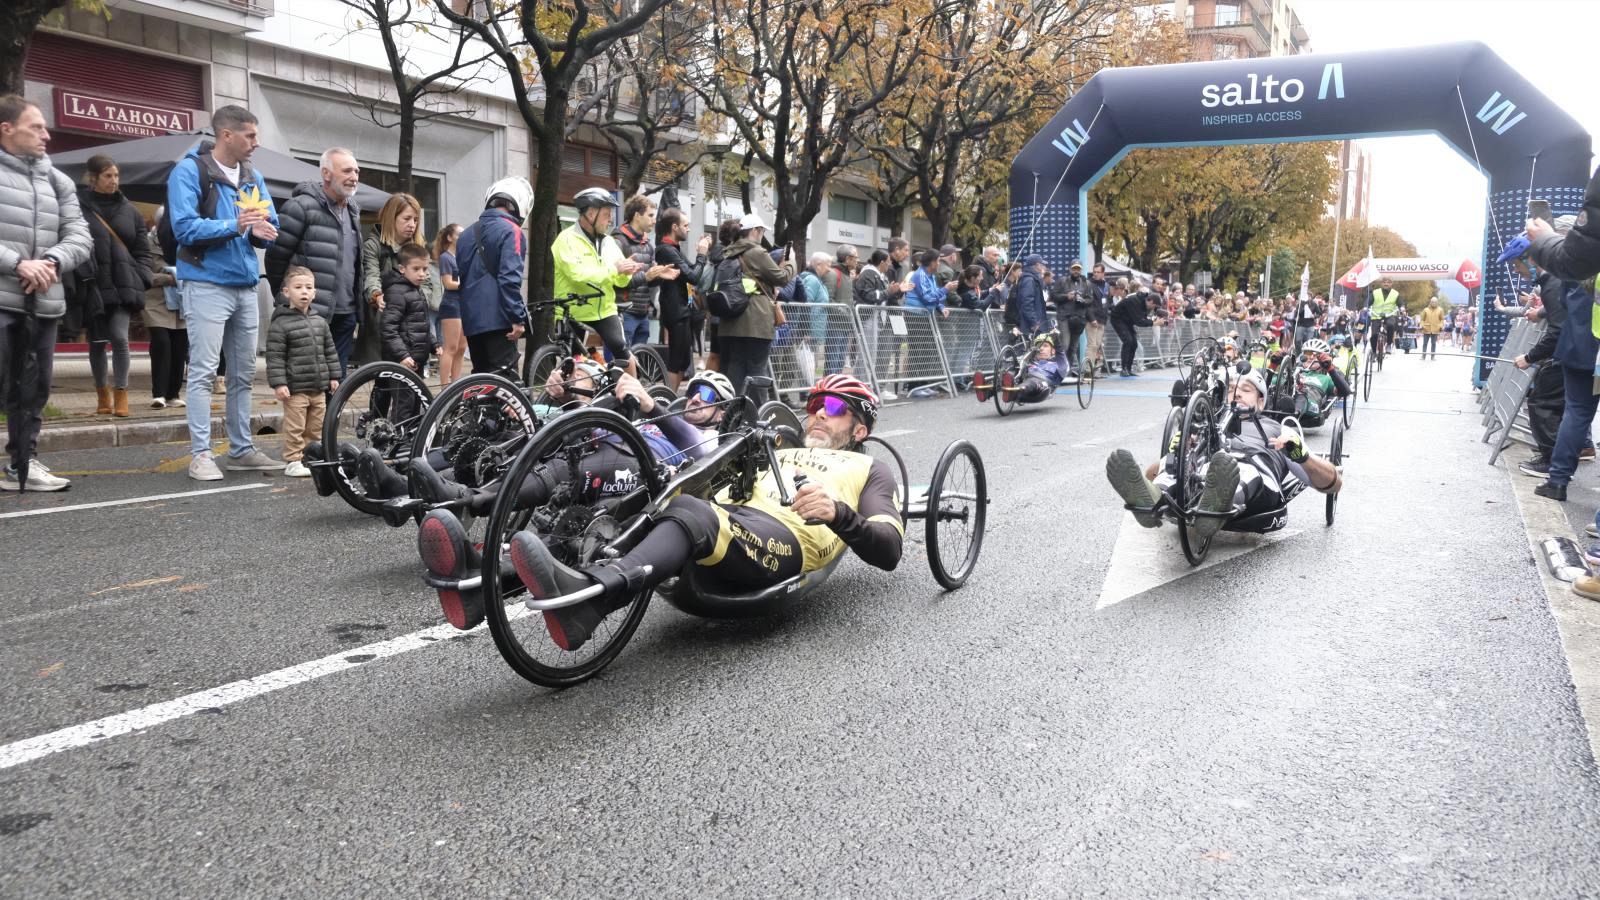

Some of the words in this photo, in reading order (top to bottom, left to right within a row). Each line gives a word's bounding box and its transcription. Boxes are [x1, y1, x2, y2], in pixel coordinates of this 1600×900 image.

[1201, 73, 1304, 108] salto
[71, 97, 99, 117] LA
[105, 106, 183, 130] TAHONA
[1202, 113, 1253, 125] INSPIRED
[1256, 110, 1302, 122] ACCESS
[104, 122, 155, 137] PANADERIA
[1419, 263, 1449, 271] VASCO
[762, 554, 779, 572] Cid
